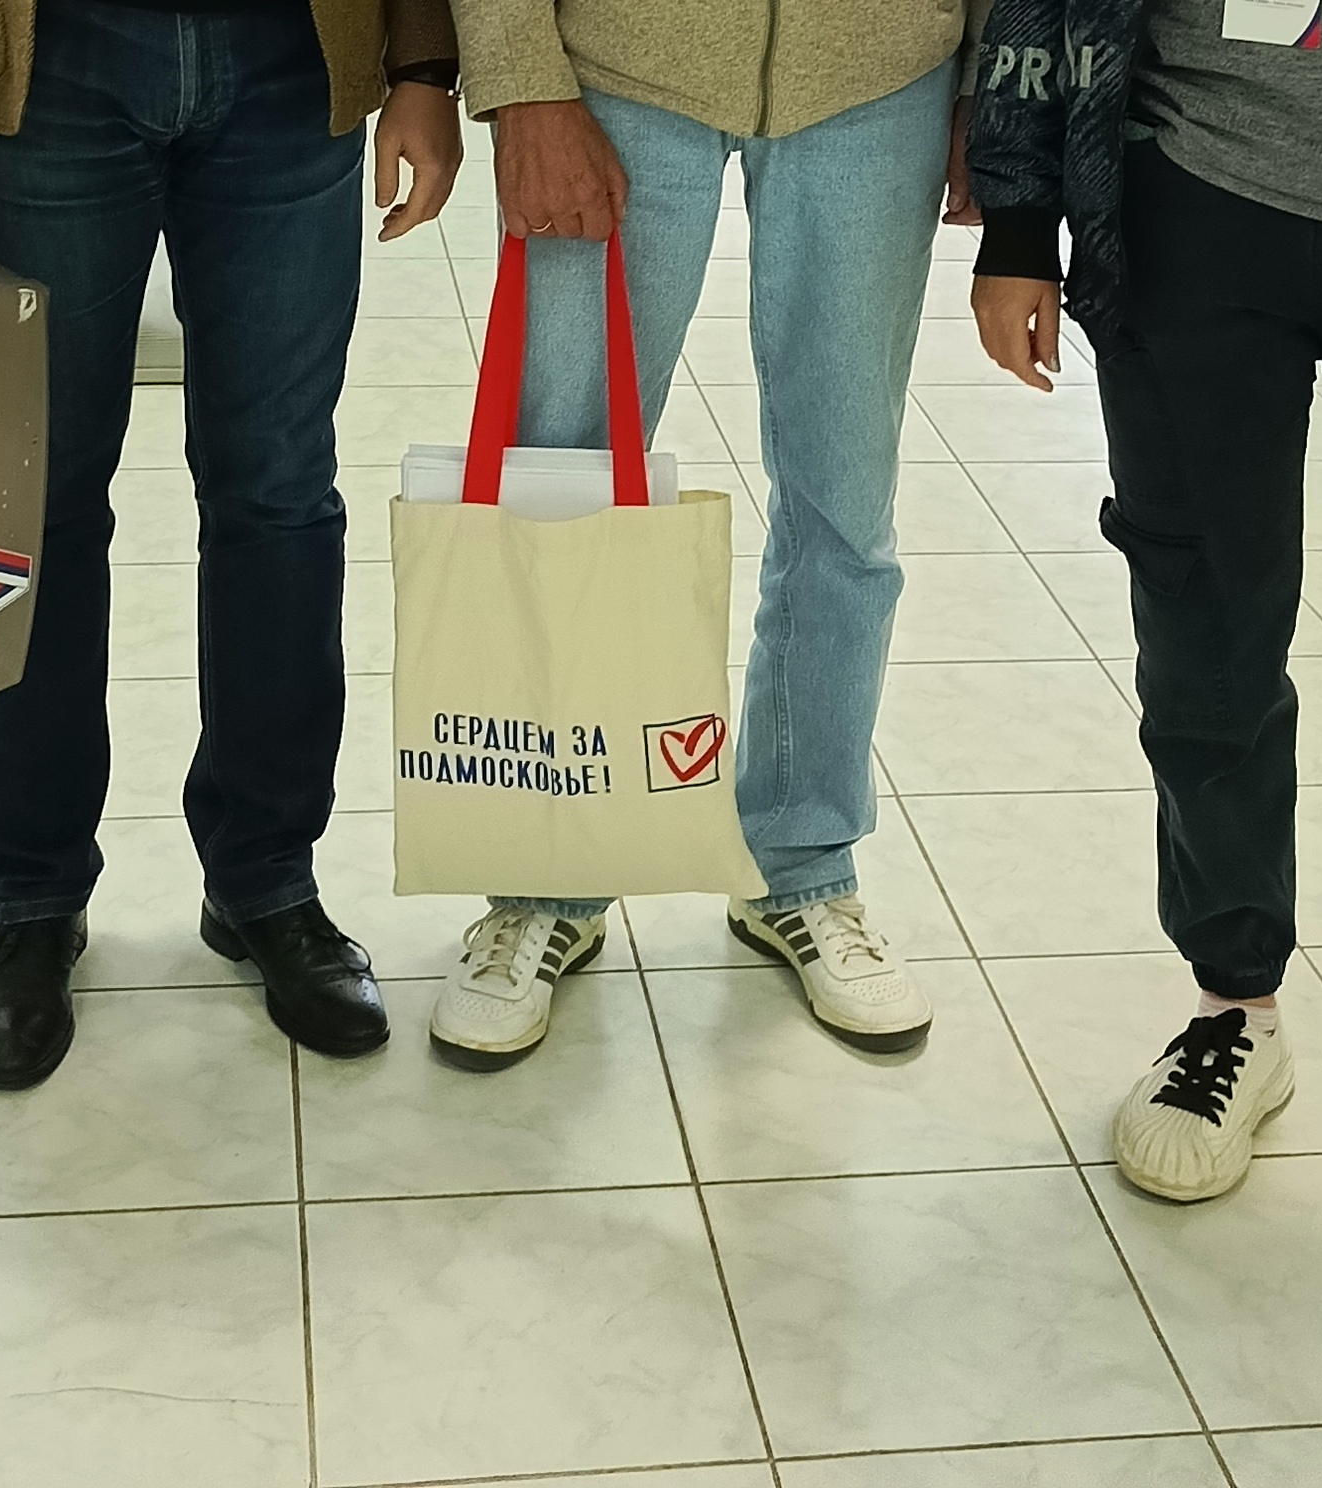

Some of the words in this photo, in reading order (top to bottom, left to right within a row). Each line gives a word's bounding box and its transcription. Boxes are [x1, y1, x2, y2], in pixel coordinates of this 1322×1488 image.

[434, 712, 555, 759] СЕРДЦЕМ
[573, 725, 607, 757] ЗА
[400, 749, 611, 797] ПОДМОСКОВЬЕ!
